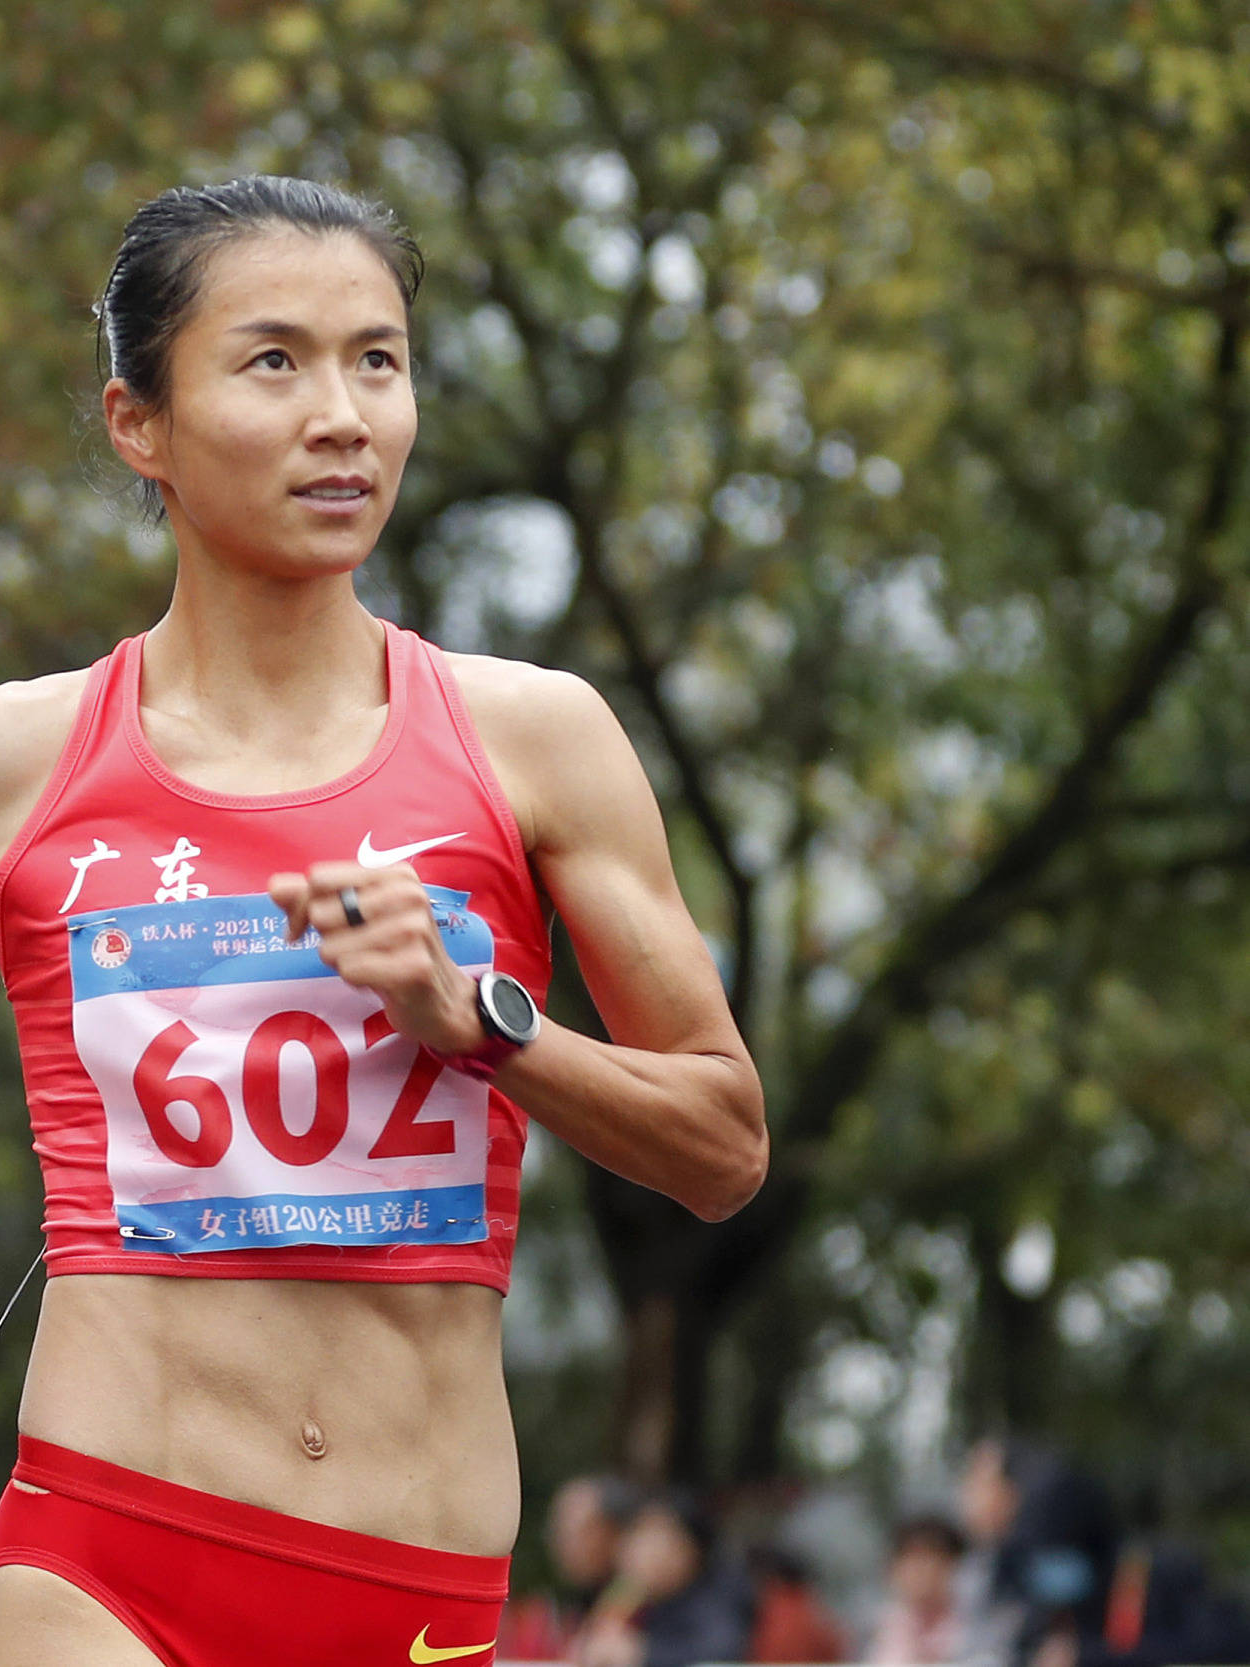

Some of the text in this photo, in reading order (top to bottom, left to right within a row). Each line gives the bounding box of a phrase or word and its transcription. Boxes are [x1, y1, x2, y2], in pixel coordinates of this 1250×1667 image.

[57, 836, 210, 915] 广东
[141, 915, 289, 942] 铁人杯·2021年
[133, 1009, 456, 1168] 602
[196, 1199, 430, 1241] 女子组20公里竞走
